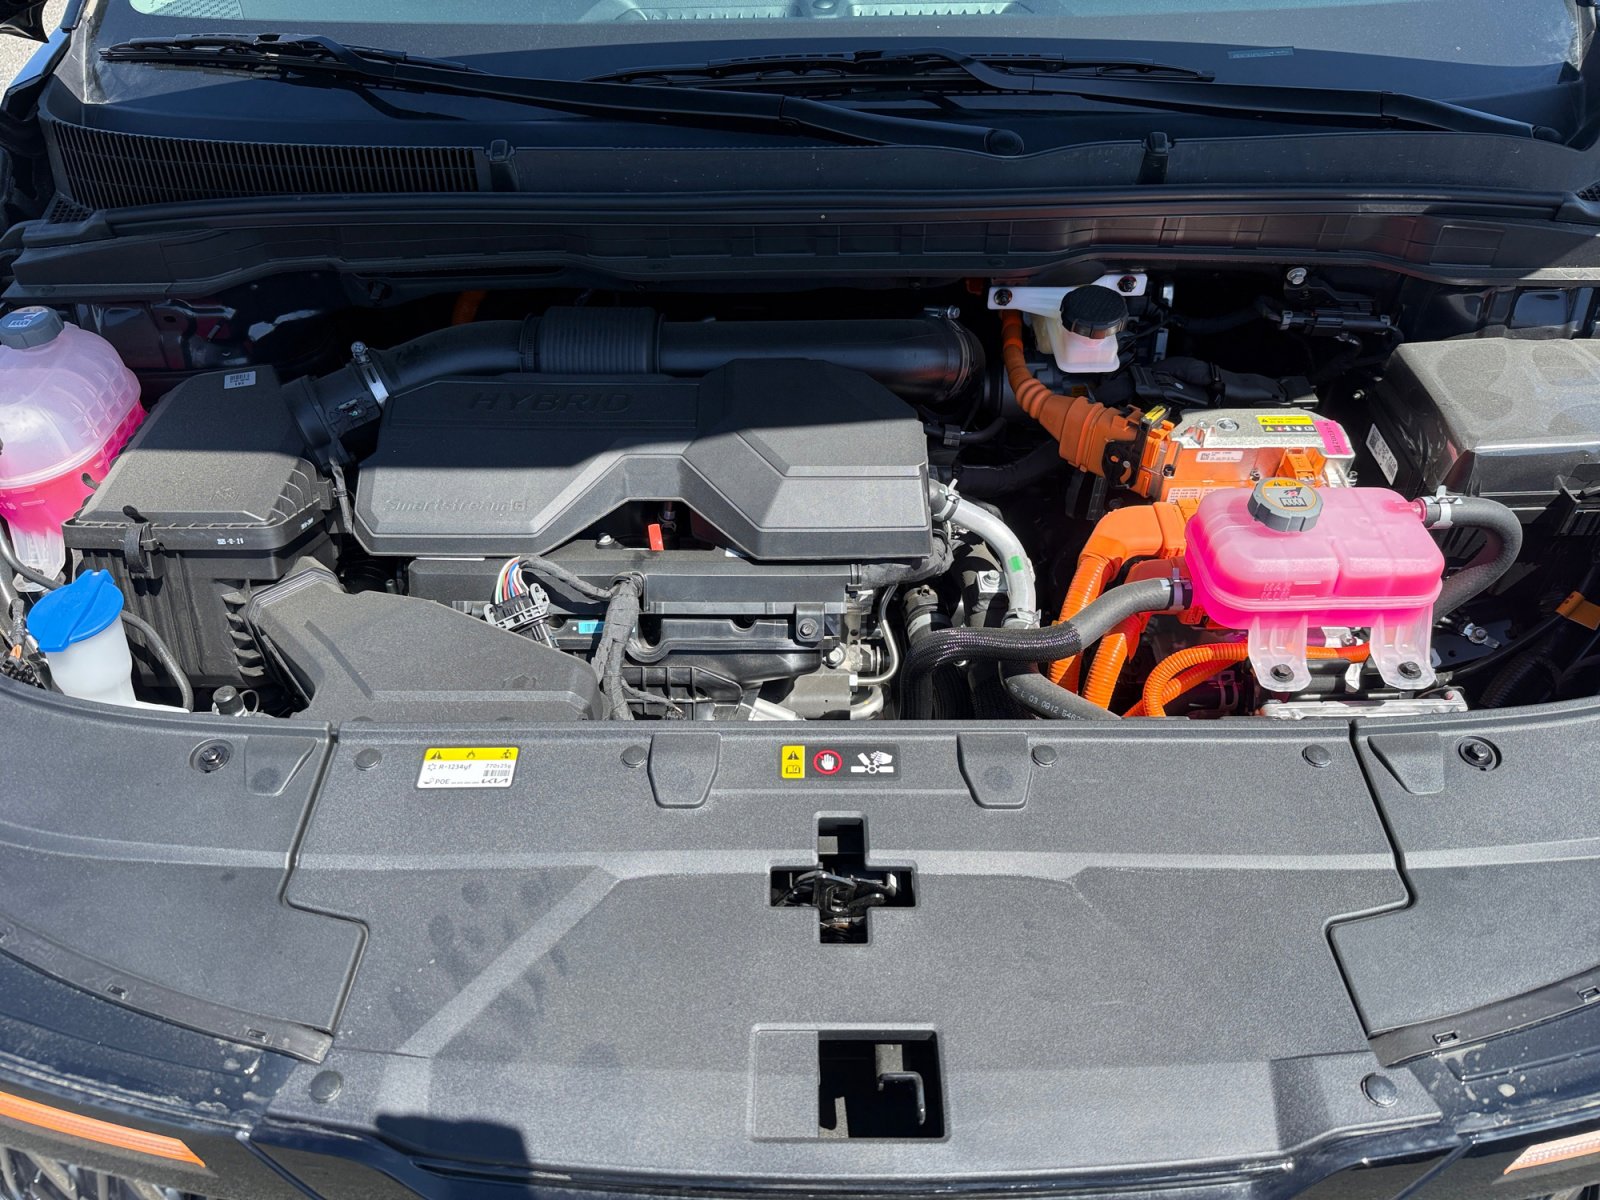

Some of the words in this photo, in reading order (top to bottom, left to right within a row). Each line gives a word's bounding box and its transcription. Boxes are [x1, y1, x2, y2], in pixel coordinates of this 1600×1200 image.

[468, 392, 632, 413] HYBRID
[383, 498, 506, 512] Smartstream
[438, 763, 472, 771] R-1234yf
